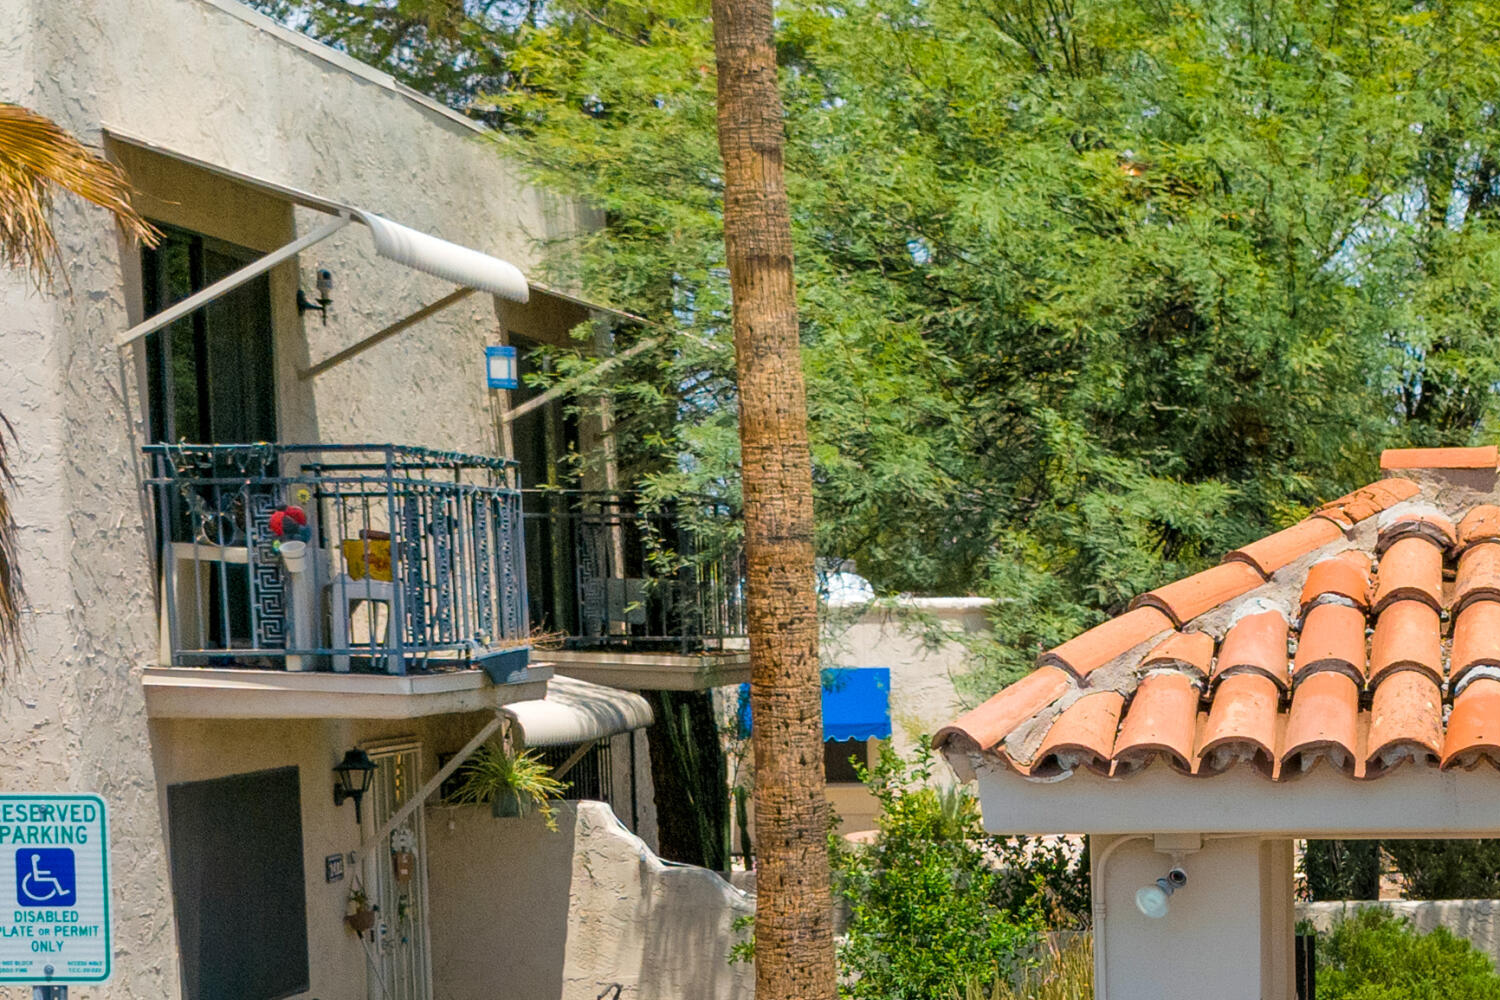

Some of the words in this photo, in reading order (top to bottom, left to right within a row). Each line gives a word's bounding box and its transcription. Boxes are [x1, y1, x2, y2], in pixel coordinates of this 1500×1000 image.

[0, 803, 97, 823] ESERVED
[0, 825, 88, 845] PARKING
[14, 910, 79, 923] DISABLED
[54, 925, 99, 937] PERMIT
[31, 940, 64, 953] ONLY
